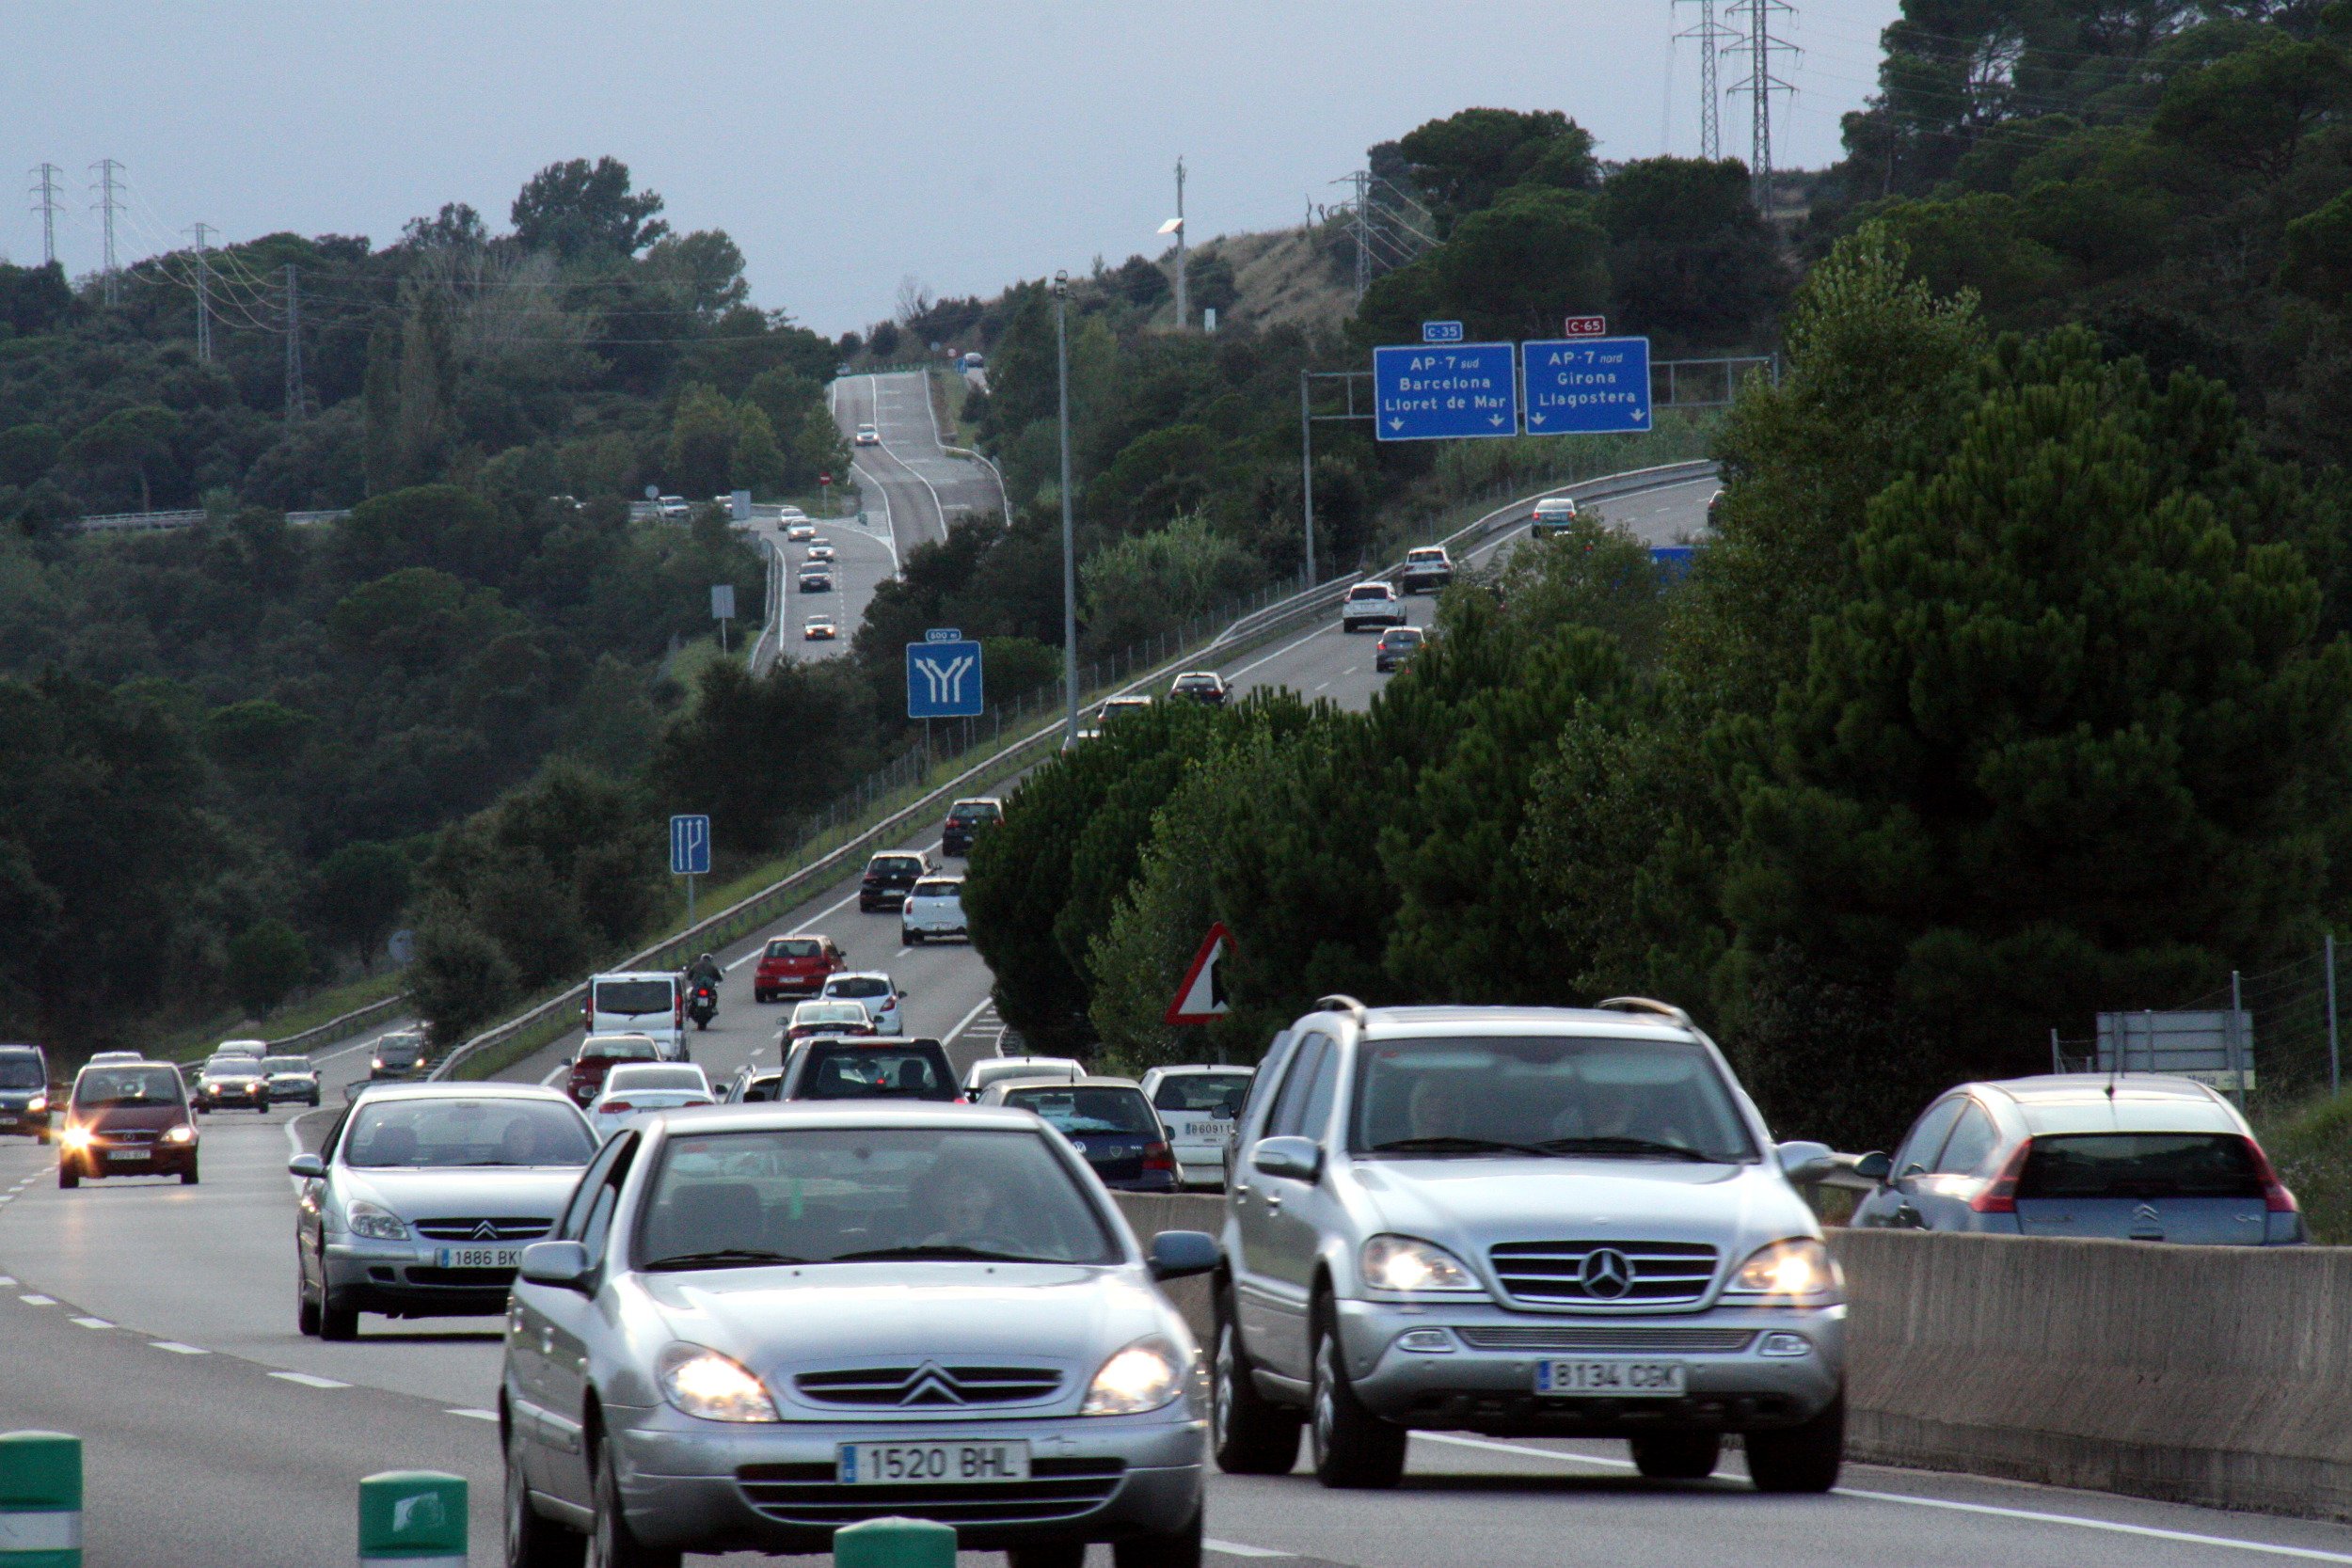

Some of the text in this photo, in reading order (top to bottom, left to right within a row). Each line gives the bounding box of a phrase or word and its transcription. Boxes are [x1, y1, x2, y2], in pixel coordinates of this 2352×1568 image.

[1427, 326, 1457, 337] C-35
[1570, 321, 1600, 331] C-65
[1410, 356, 1480, 371] AP-7 sud
[1549, 351, 1623, 365] AP-7 nord
[1399, 377, 1491, 391] Barcelona
[1557, 372, 1616, 385] Girona
[1385, 395, 1506, 411] Lloret de Mar
[1539, 390, 1636, 408] Llagostera
[455, 1250, 522, 1265] 1886 BK
[1555, 1364, 1621, 1387] 8134
[870, 1447, 1016, 1479] 1520 BHL
